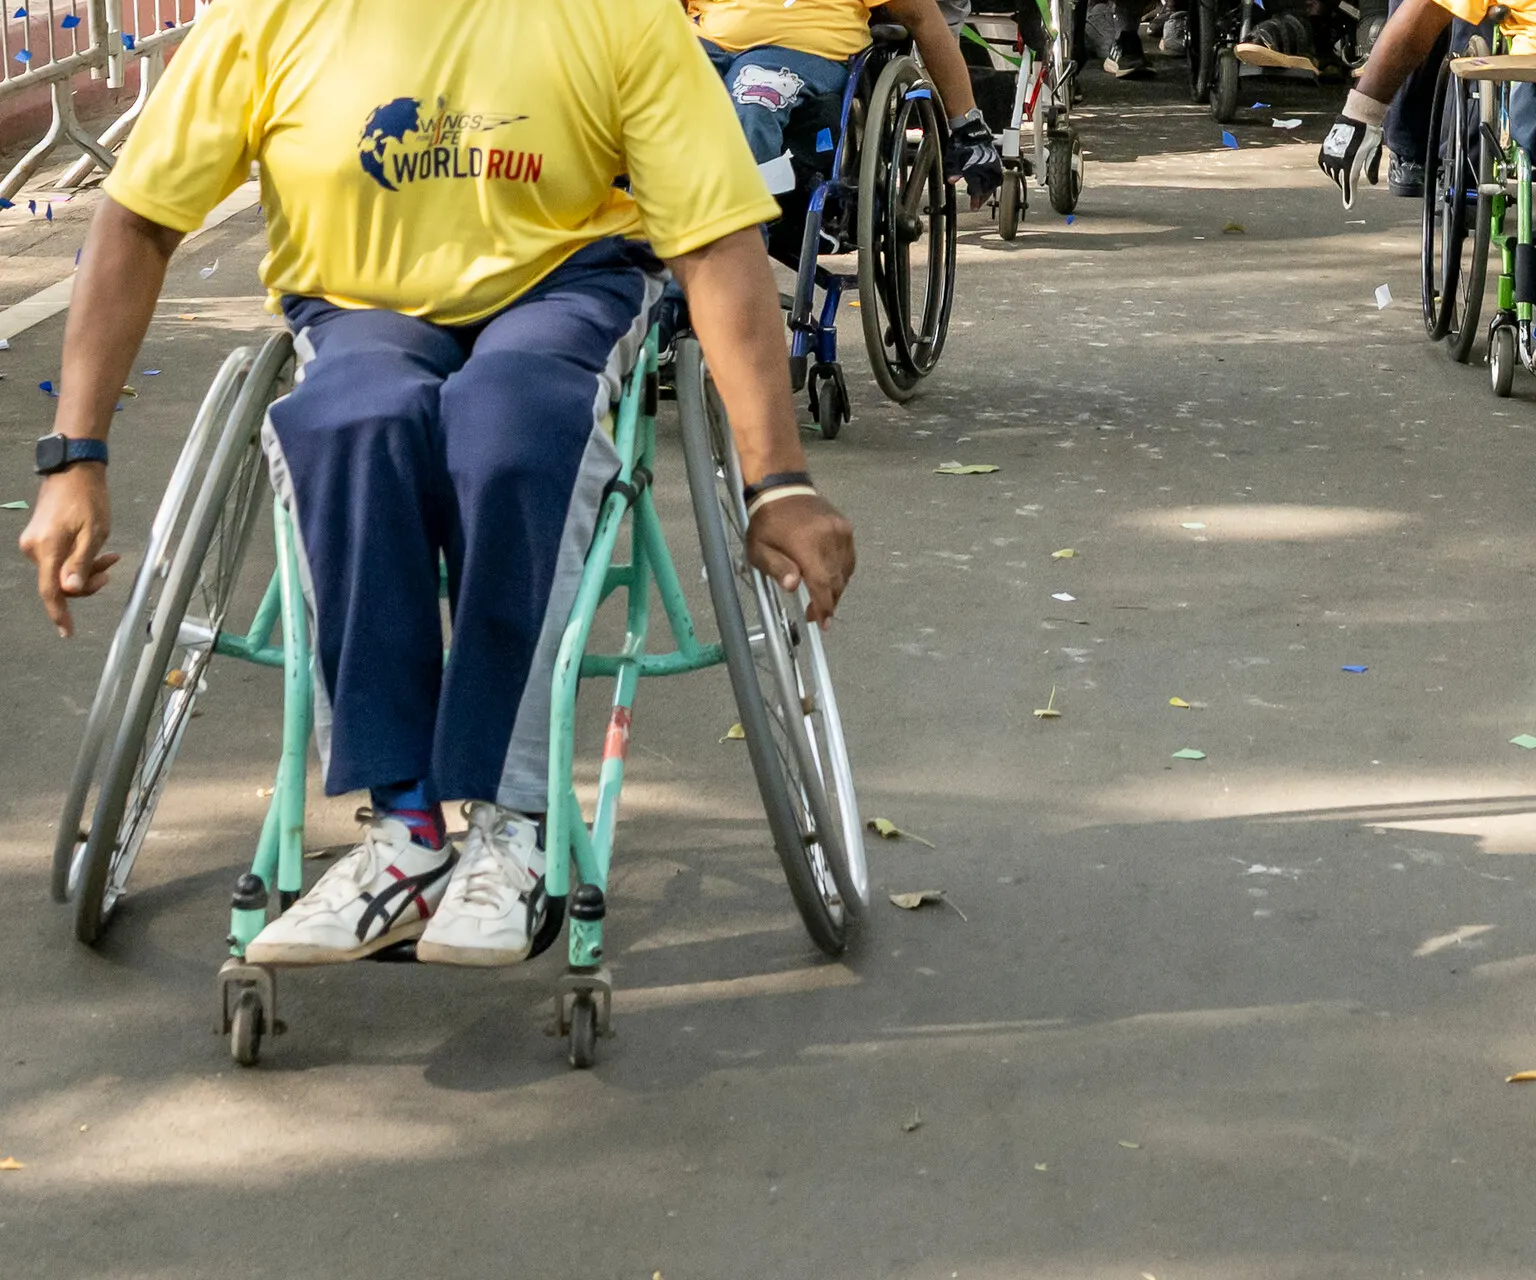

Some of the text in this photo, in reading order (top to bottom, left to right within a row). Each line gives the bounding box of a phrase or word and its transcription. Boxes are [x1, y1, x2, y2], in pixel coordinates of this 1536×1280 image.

[419, 110, 483, 134] WINGS
[393, 146, 544, 184] WORLD RUN
